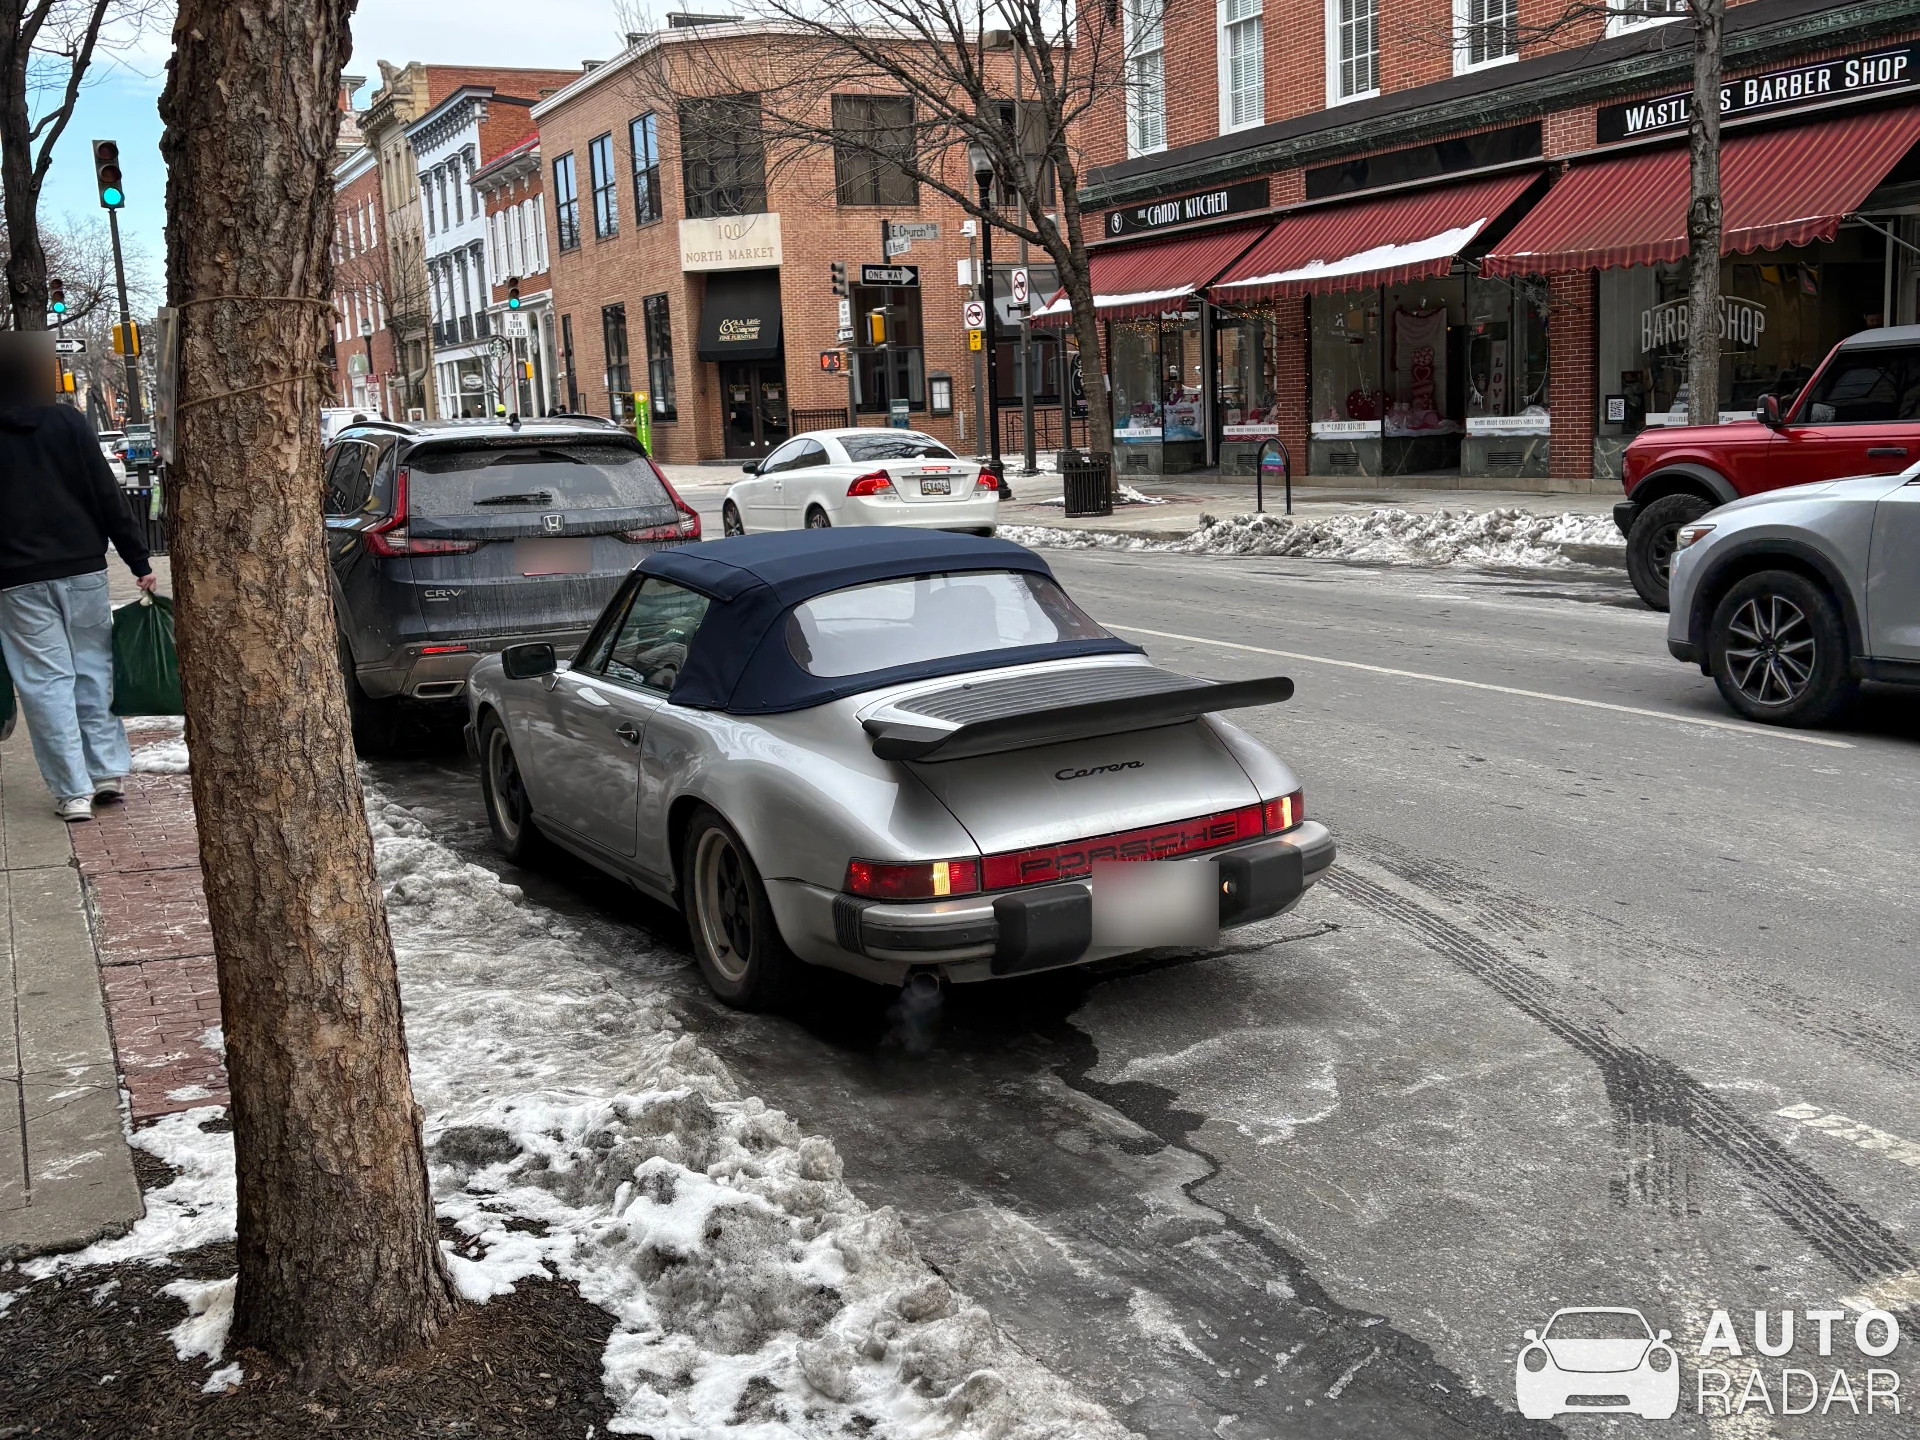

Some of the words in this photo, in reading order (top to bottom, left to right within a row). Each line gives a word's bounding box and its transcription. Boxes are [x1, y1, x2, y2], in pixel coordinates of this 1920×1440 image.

[1625, 87, 1731, 132] WASTLS
[1744, 68, 1831, 106] BARBER
[1845, 56, 1908, 88] SHOP
[1147, 201, 1181, 226] CANDY
[1185, 191, 1228, 219] KITCHEN
[718, 224, 741, 240] 100
[899, 225, 926, 237] Church
[686, 250, 723, 263] NORTH
[728, 246, 775, 260] MARKET
[868, 270, 883, 279] ONE
[887, 271, 903, 280] WAY
[509, 321, 522, 329] TURN
[1641, 304, 1690, 354] BARB
[1054, 760, 1145, 781] Carrera
[1021, 821, 1236, 877] PORSCHE
